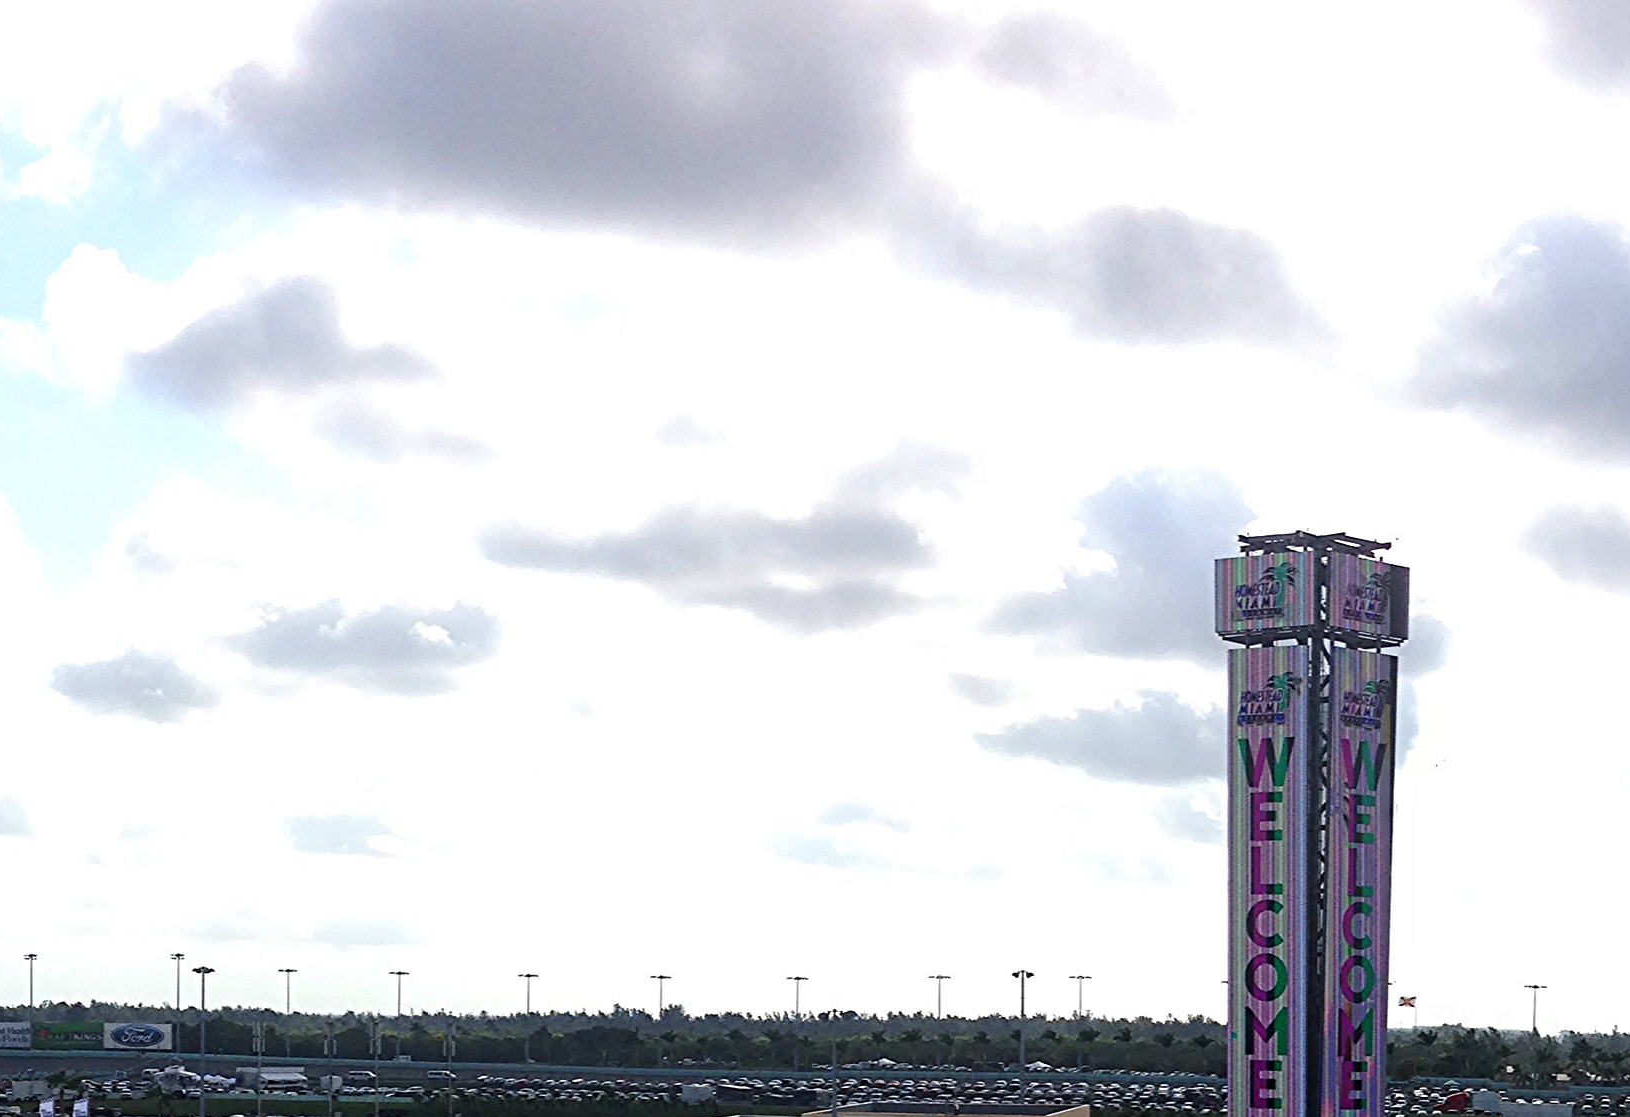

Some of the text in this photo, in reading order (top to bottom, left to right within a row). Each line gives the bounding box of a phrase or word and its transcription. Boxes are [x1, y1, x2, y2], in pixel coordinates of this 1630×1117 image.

[1236, 599, 1279, 611] MIAMI
[1239, 702, 1282, 715] MIAMI
[1239, 737, 1296, 1110] WELCOME
[1338, 738, 1387, 1110] WELCOME
